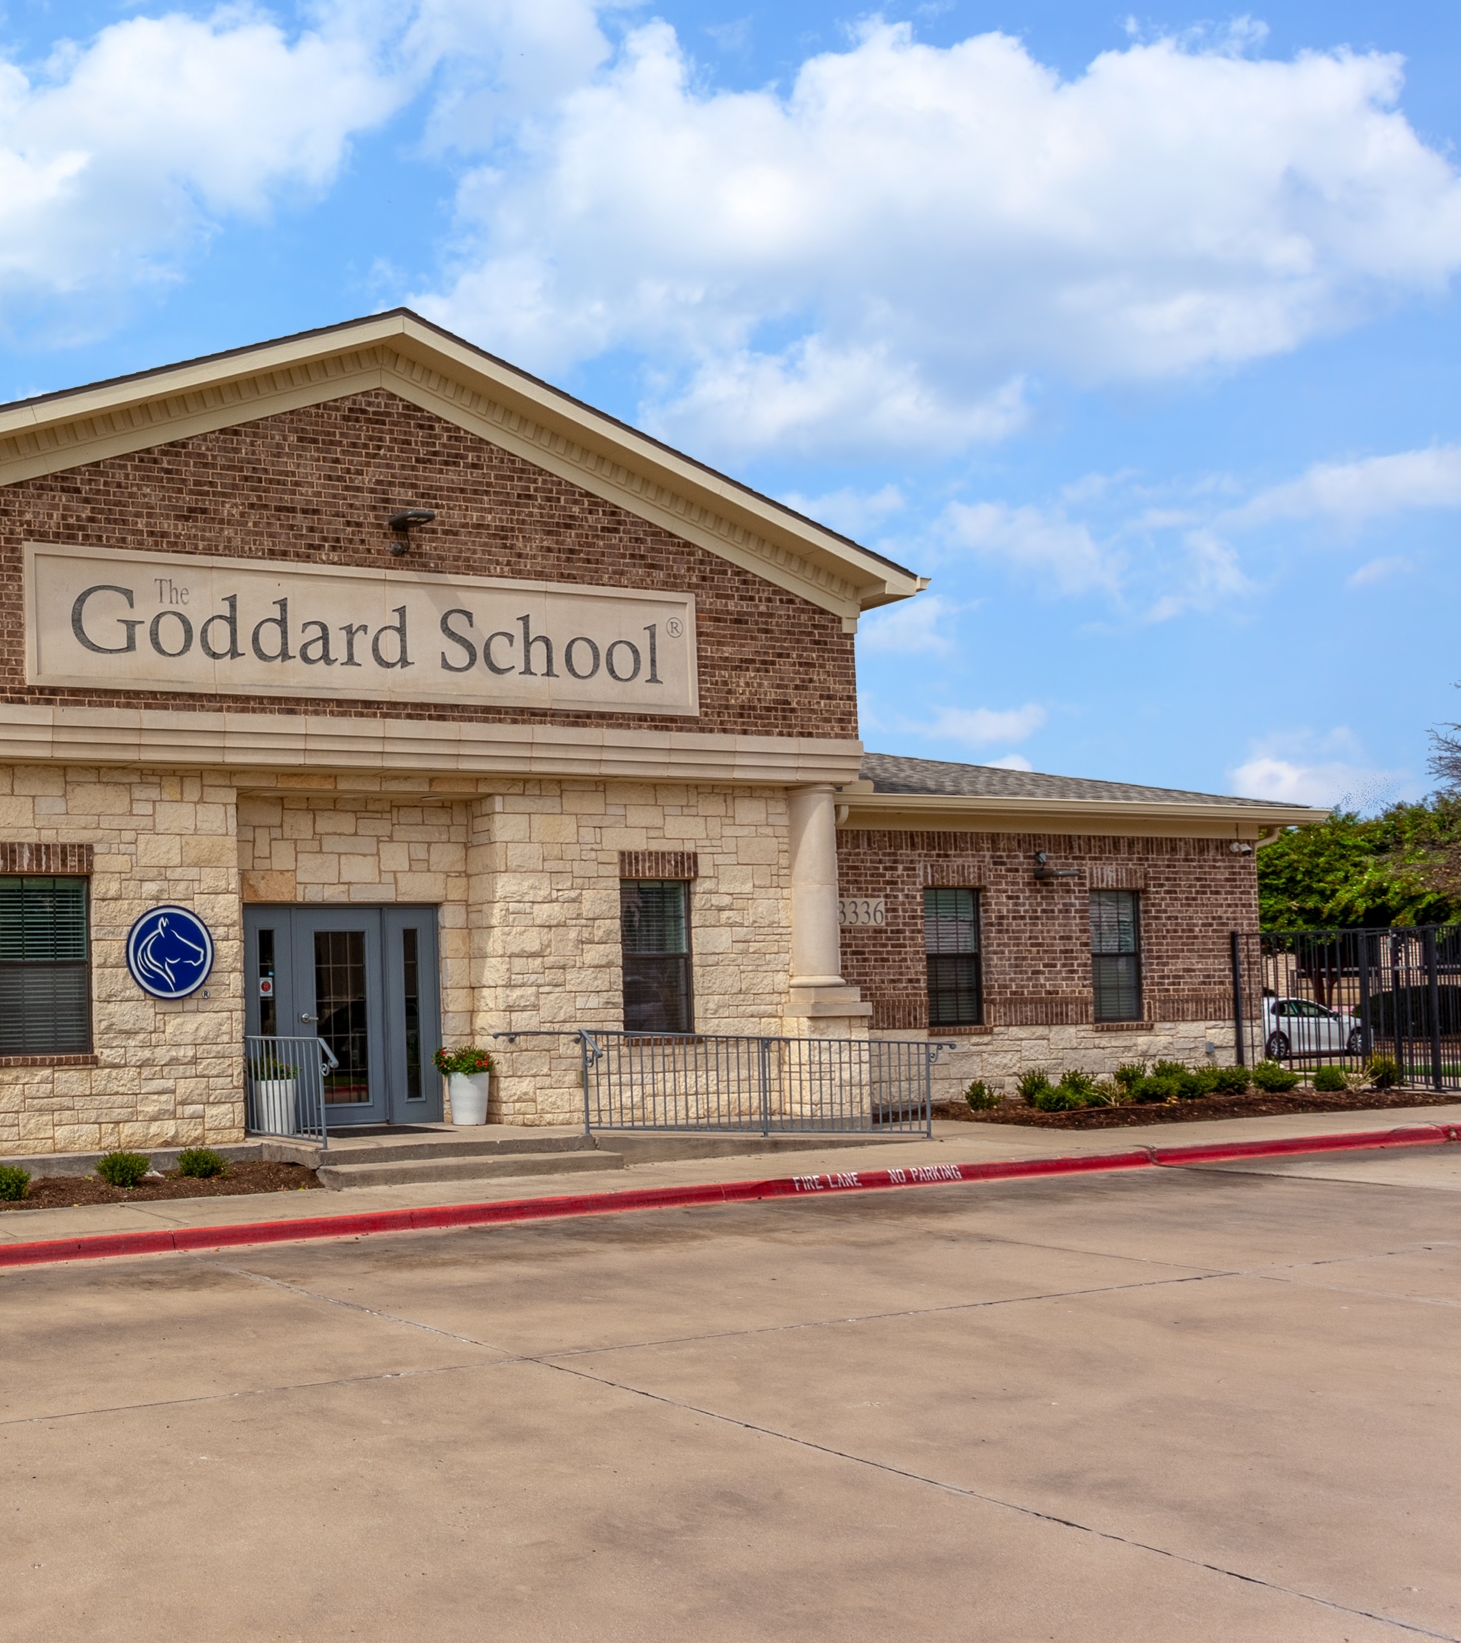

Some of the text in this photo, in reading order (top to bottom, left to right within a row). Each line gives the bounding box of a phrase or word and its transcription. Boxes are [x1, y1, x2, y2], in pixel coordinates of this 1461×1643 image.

[154, 578, 190, 606] The
[70, 584, 415, 669] Goddard
[838, 900, 884, 925] 3336
[792, 1164, 962, 1191] FIRE LANE NO PARKING
